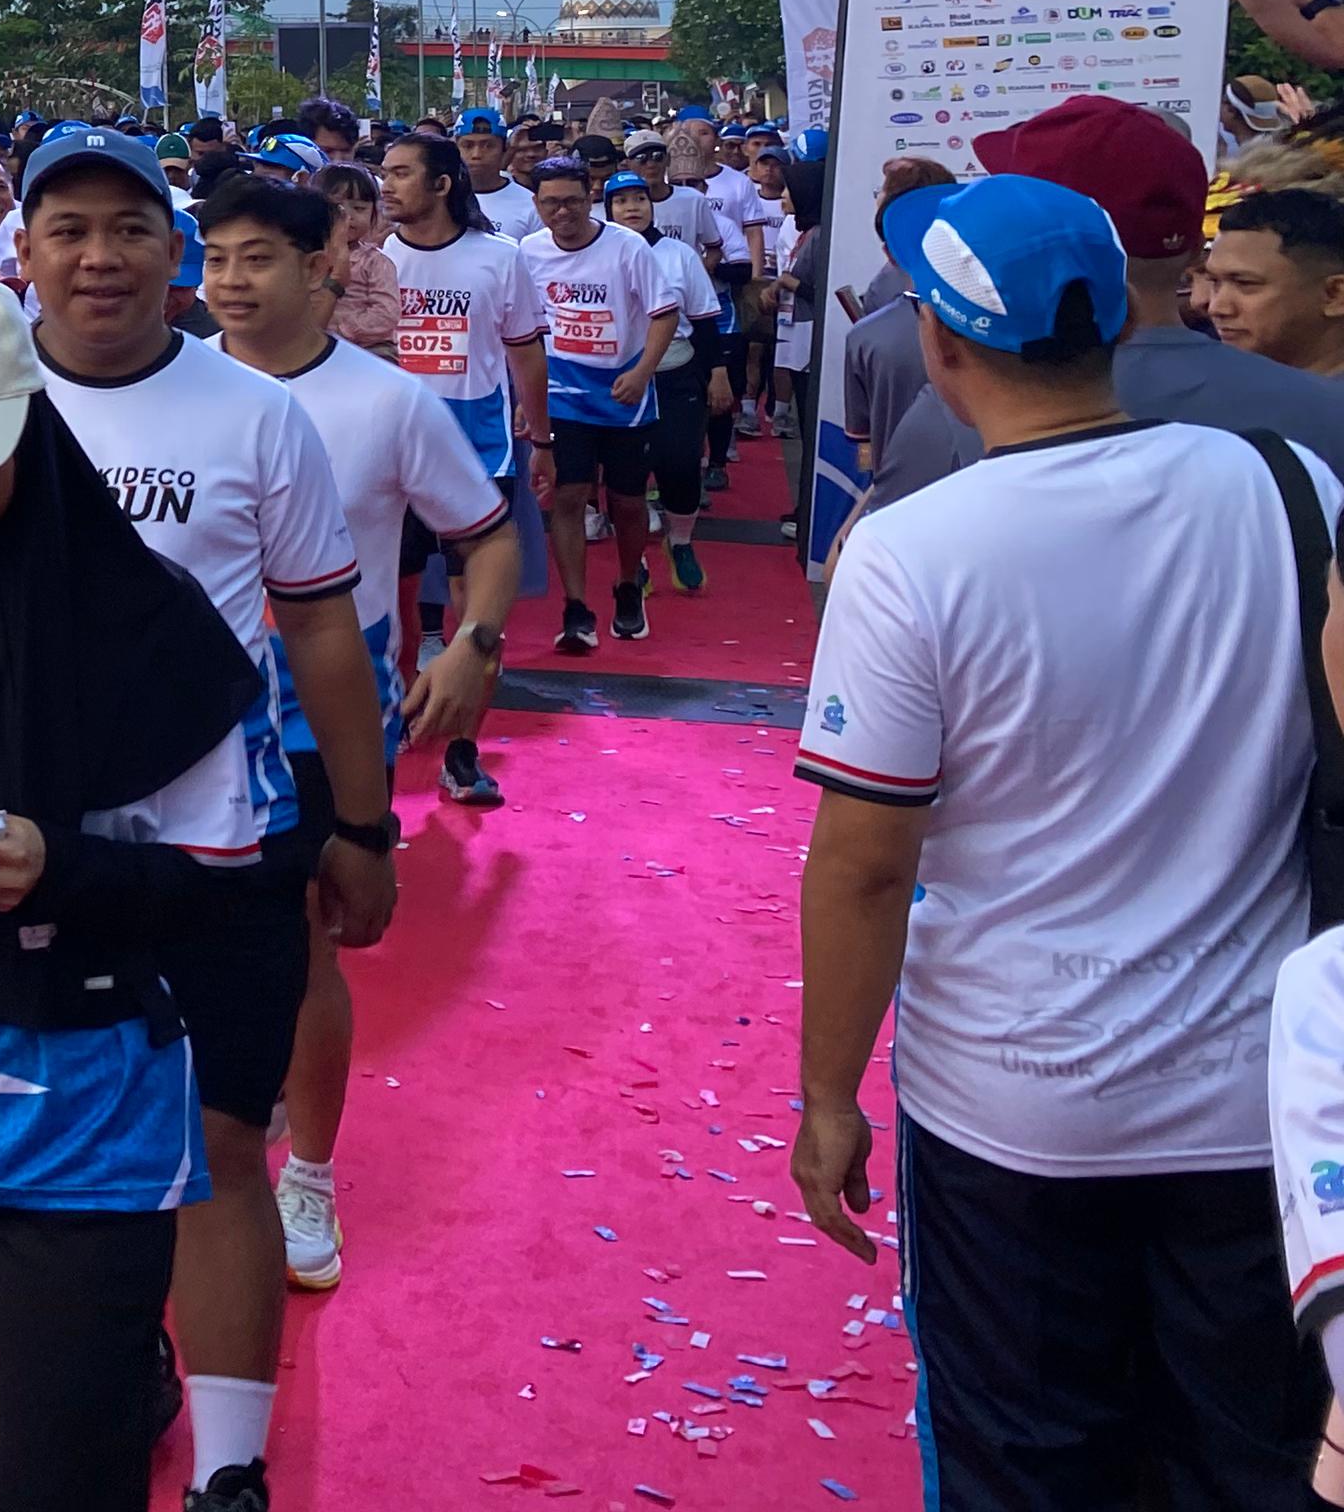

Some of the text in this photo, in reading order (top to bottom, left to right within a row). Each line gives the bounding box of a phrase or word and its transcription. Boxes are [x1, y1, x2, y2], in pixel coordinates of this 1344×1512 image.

[87, 135, 105, 147] m
[424, 289, 471, 300] KIDECO
[571, 290, 608, 304] RUN
[421, 298, 470, 317] RUN
[563, 324, 603, 339] 7057
[399, 335, 453, 352] 6075
[97, 467, 195, 487] KIDECO
